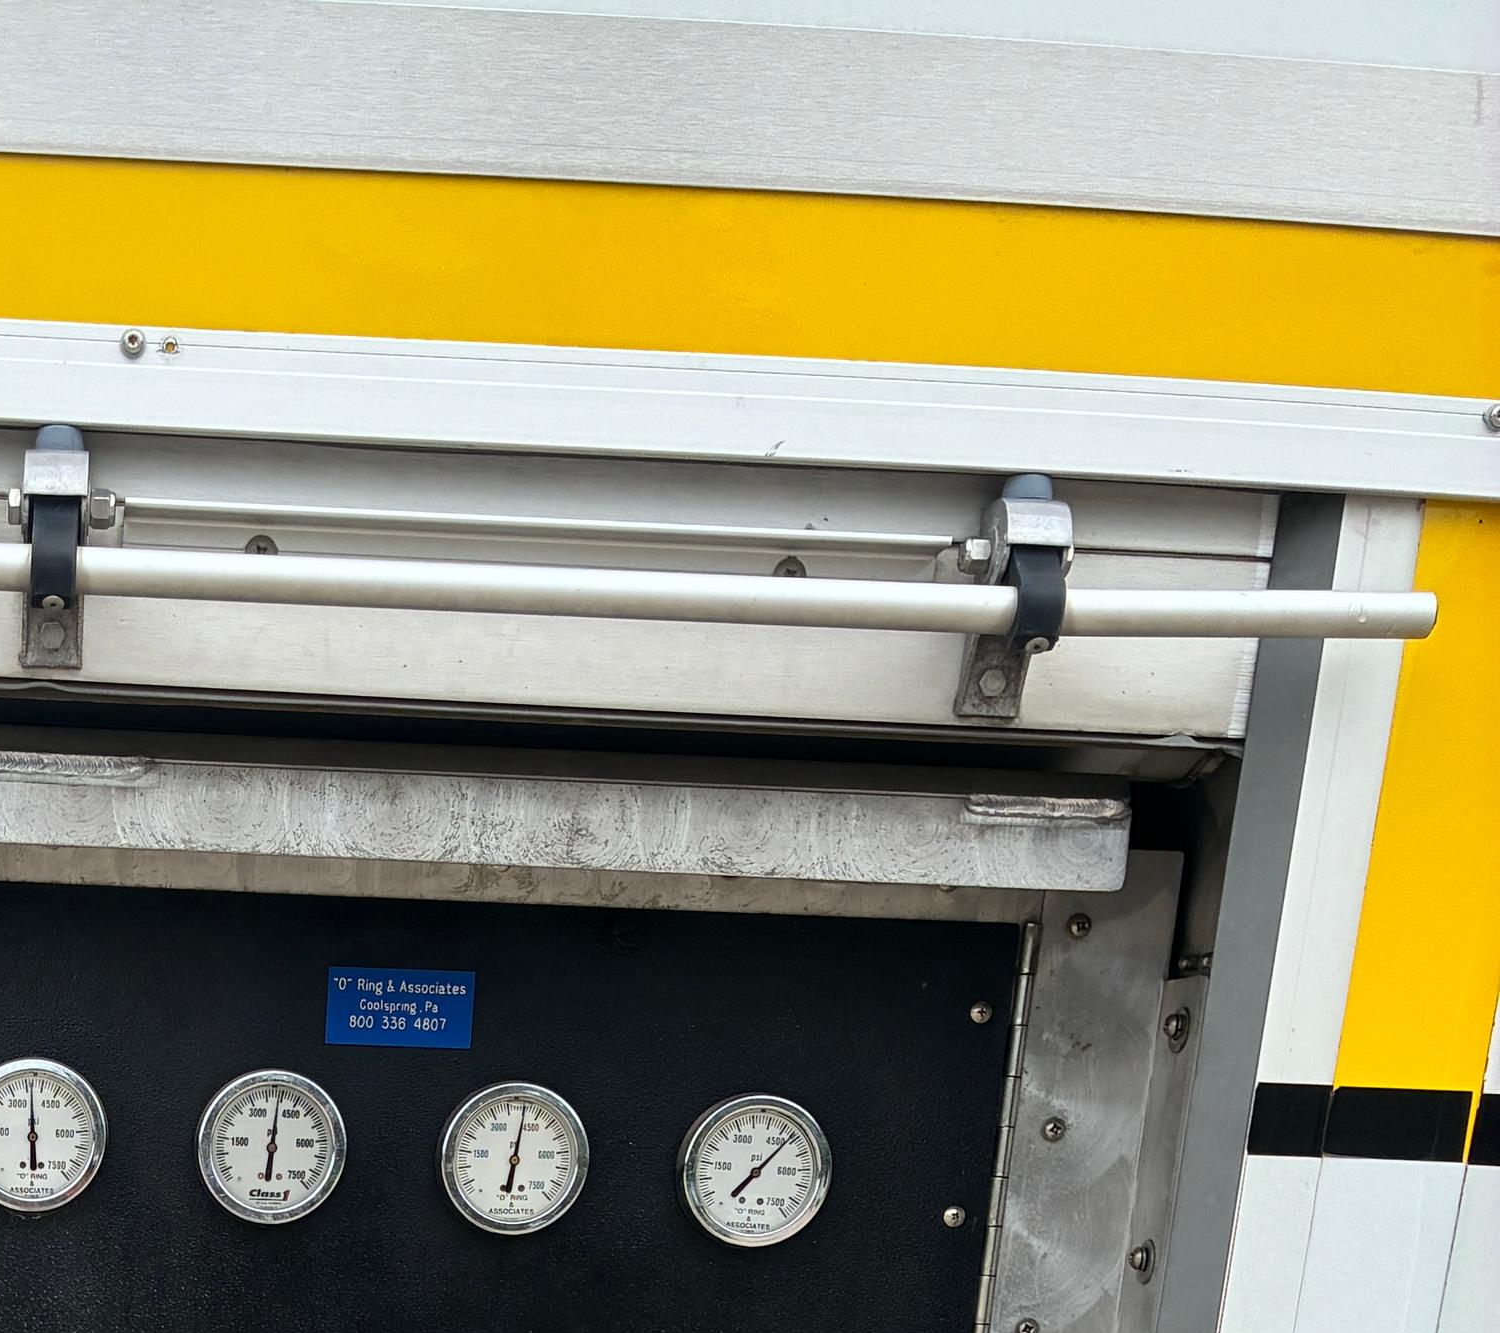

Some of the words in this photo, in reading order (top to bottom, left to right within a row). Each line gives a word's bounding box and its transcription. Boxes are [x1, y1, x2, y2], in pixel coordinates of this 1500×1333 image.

[357, 978, 383, 996] Ring
[387, 979, 396, 993] &
[399, 980, 467, 995] Associates
[425, 1001, 438, 1014] Pa
[349, 1015, 374, 1029] 800
[414, 1017, 447, 1031] 4807
[8, 1099, 27, 1108] 3000
[41, 1099, 60, 1109] 4500
[248, 1108, 267, 1118] 3000
[282, 1109, 300, 1119] 4500
[490, 1122, 507, 1132] 3000
[523, 1122, 540, 1132] 4500
[55, 1129, 74, 1138] 6000
[231, 1136, 248, 1147] 1500
[295, 1138, 314, 1148] 6000
[733, 1134, 752, 1144] 3000
[766, 1136, 786, 1146] 4500
[473, 1149, 489, 1159] 1500
[538, 1150, 555, 1160] 6000
[750, 1153, 763, 1162] psi
[47, 1160, 67, 1170] 7500
[714, 1161, 732, 1171] 1500
[287, 1170, 306, 1180] 7500
[777, 1166, 797, 1176] 6000
[528, 1180, 545, 1190] 7500
[766, 1197, 785, 1207] 7500
[488, 1208, 535, 1216] ASSOCIATES
[748, 1208, 766, 1216] RING
[726, 1222, 771, 1230] ASSOCIATES
